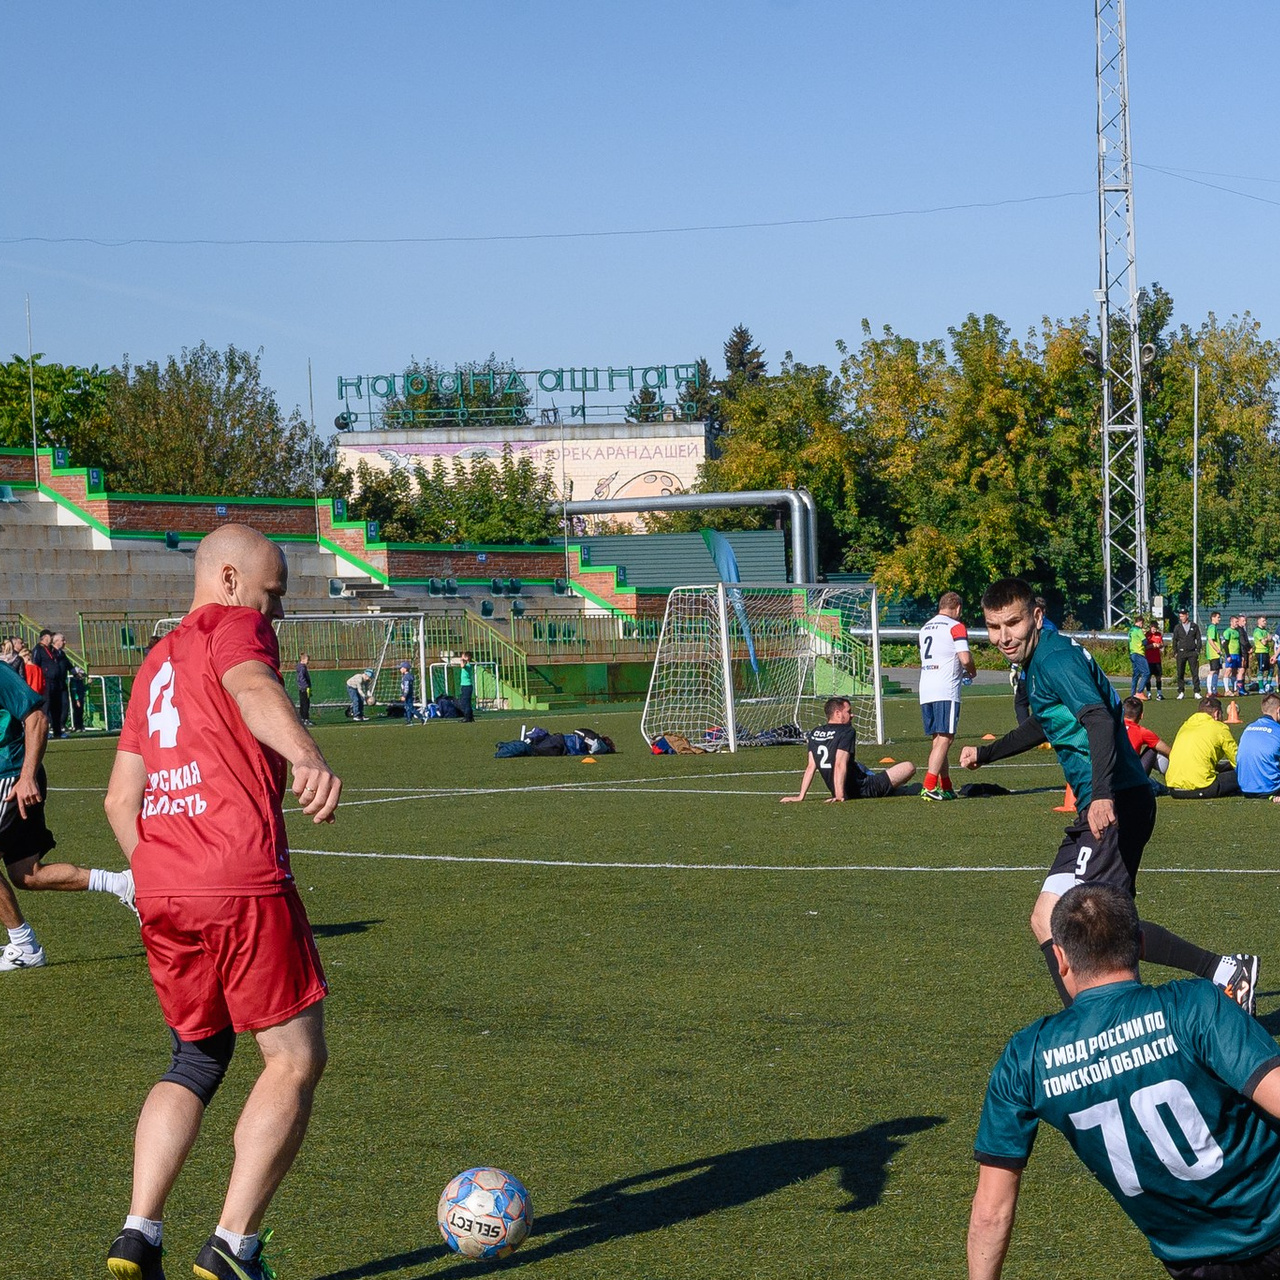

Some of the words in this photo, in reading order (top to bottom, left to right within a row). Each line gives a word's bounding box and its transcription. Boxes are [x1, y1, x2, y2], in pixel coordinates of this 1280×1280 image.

[924, 635, 933, 660] 2
[146, 656, 181, 749] 4
[816, 745, 832, 769] 2
[1075, 846, 1093, 876] 9
[1042, 1040, 1089, 1069] УМВД
[1089, 1017, 1144, 1054] РОССИИ
[1144, 1010, 1166, 1032] ПО
[1042, 1057, 1112, 1098] ТОМСКОЙ
[1112, 1034, 1179, 1075] ОБЛАСТИ
[1068, 1078, 1224, 1197] 70
[450, 1213, 501, 1238] SELECT
